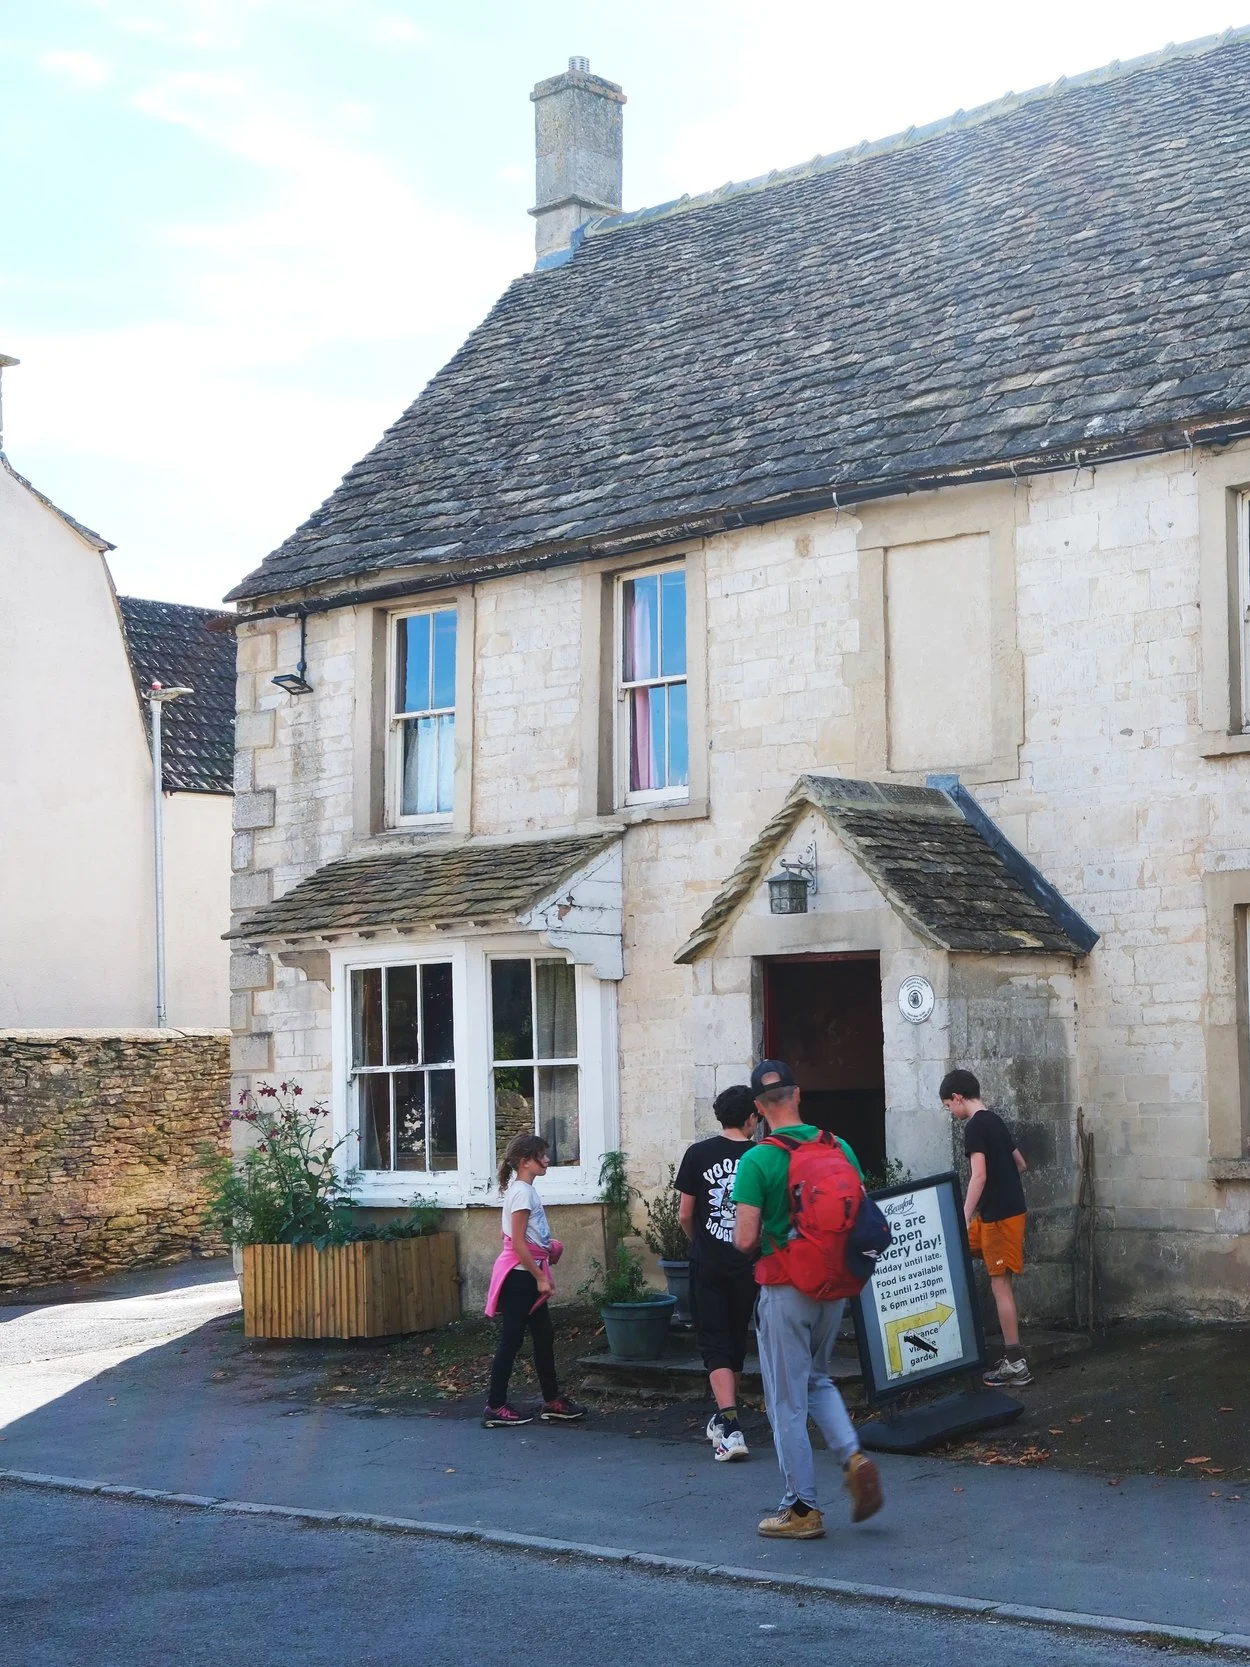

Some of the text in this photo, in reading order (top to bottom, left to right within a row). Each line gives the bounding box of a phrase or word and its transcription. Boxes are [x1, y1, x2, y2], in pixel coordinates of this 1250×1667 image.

[905, 1215, 926, 1228] are
[875, 1234, 942, 1263] every day!
[891, 1229, 922, 1246] open
[873, 1252, 942, 1276] Midday until late.
[876, 1276, 897, 1289] Food
[908, 1264, 944, 1280] available
[880, 1276, 944, 1300] 12 until 2.30pm
[880, 1287, 947, 1312] & 6pm until 9pm
[910, 1352, 939, 1367] garden
